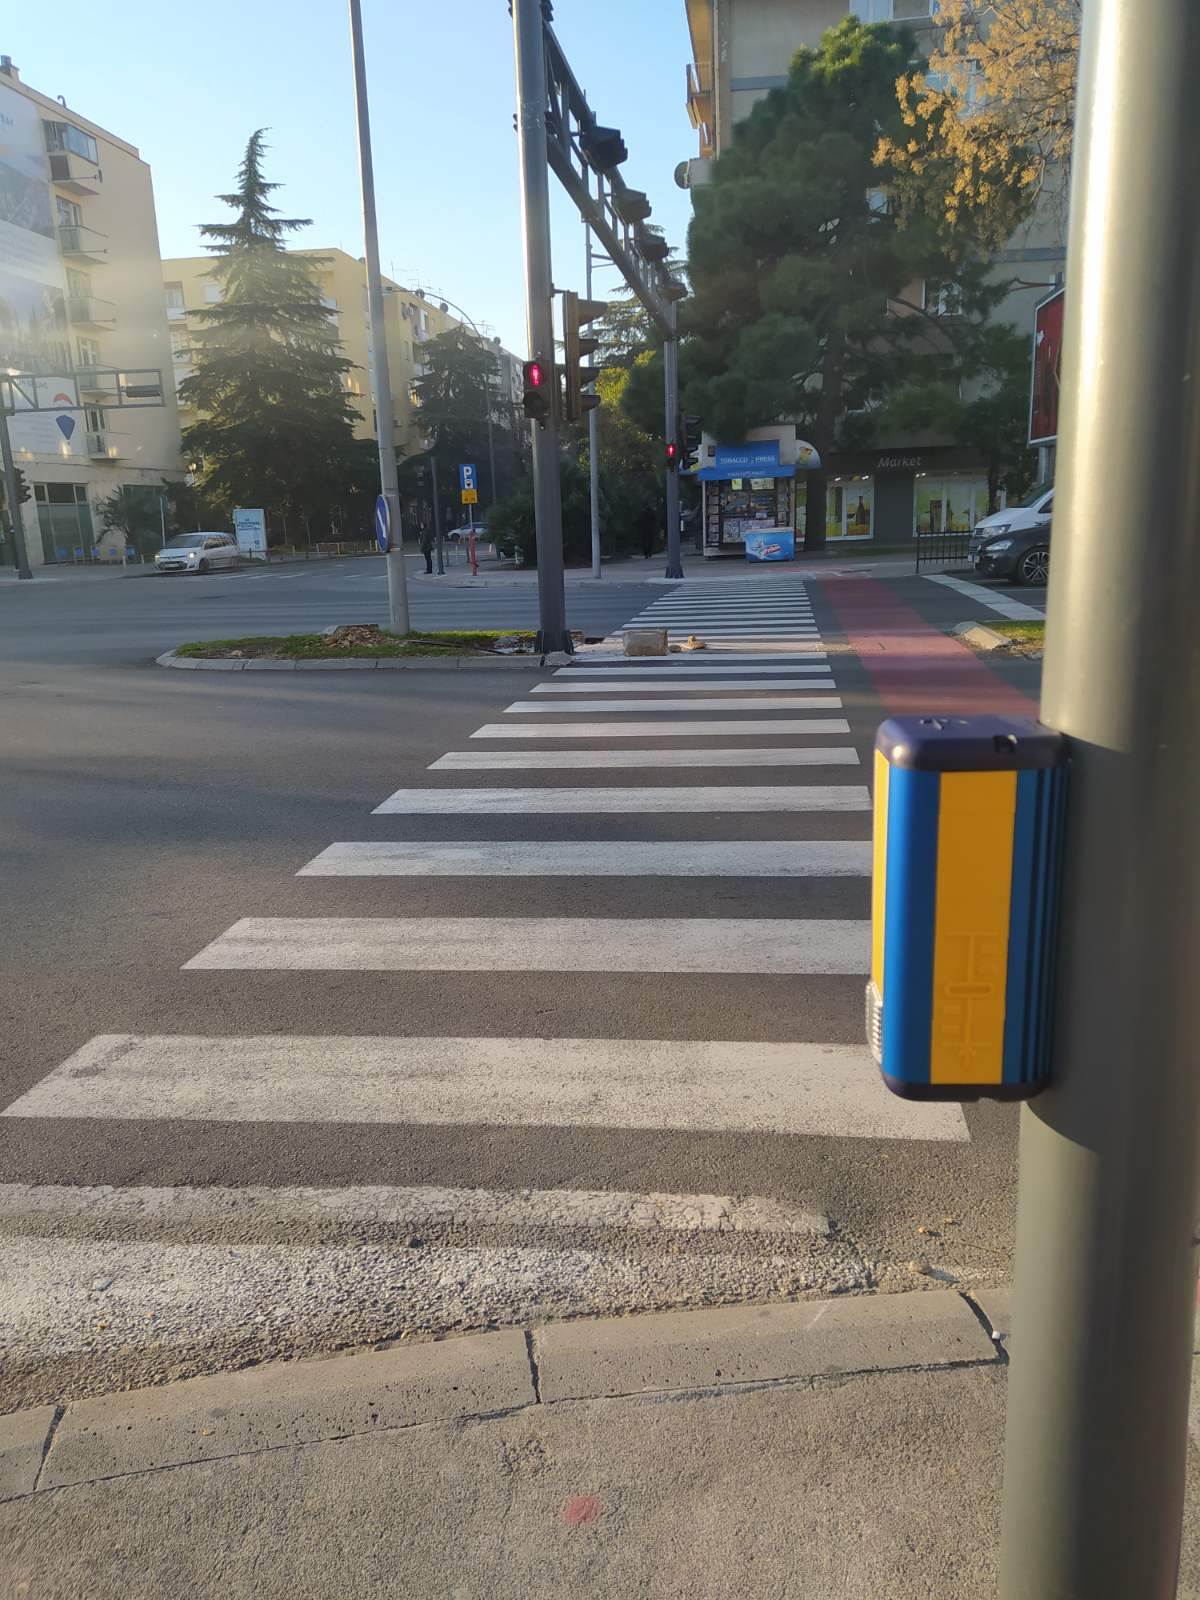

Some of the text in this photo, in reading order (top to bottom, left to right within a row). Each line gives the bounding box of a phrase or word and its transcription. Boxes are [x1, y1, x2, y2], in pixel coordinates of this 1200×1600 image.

[720, 456, 749, 465] TOBACCO
[755, 455, 776, 464] PRESS
[877, 456, 921, 468] Market
[463, 466, 473, 479] P
